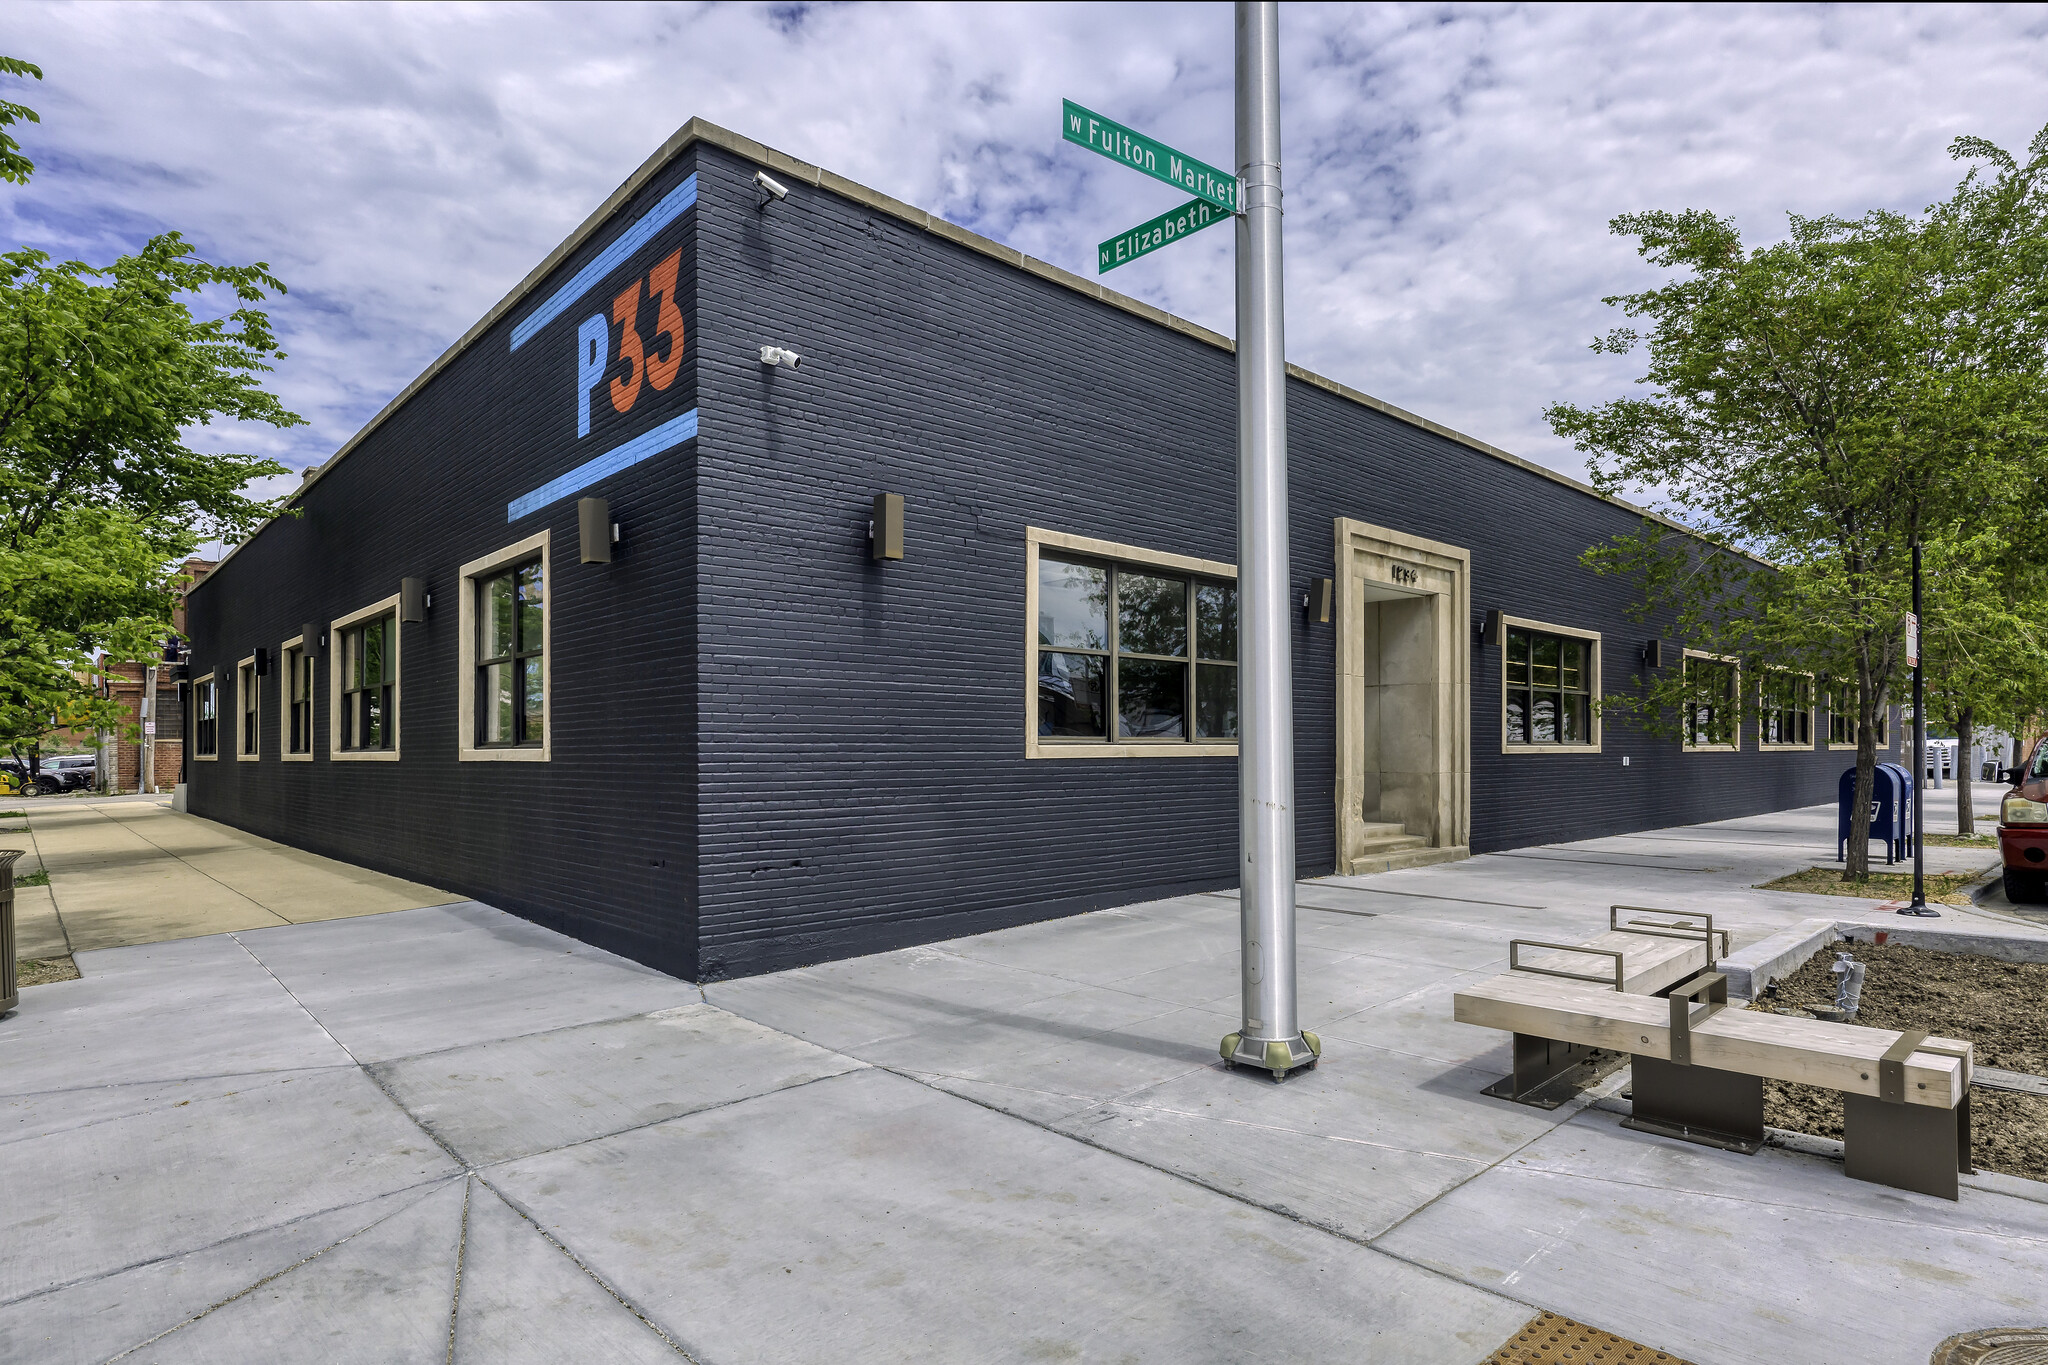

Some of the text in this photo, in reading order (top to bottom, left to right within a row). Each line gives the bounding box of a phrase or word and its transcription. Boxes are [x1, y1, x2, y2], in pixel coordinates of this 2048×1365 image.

[1070, 114, 1234, 206] W Fulton Market
[1101, 203, 1210, 265] N Elizabeth
[577, 246, 685, 440] P33
